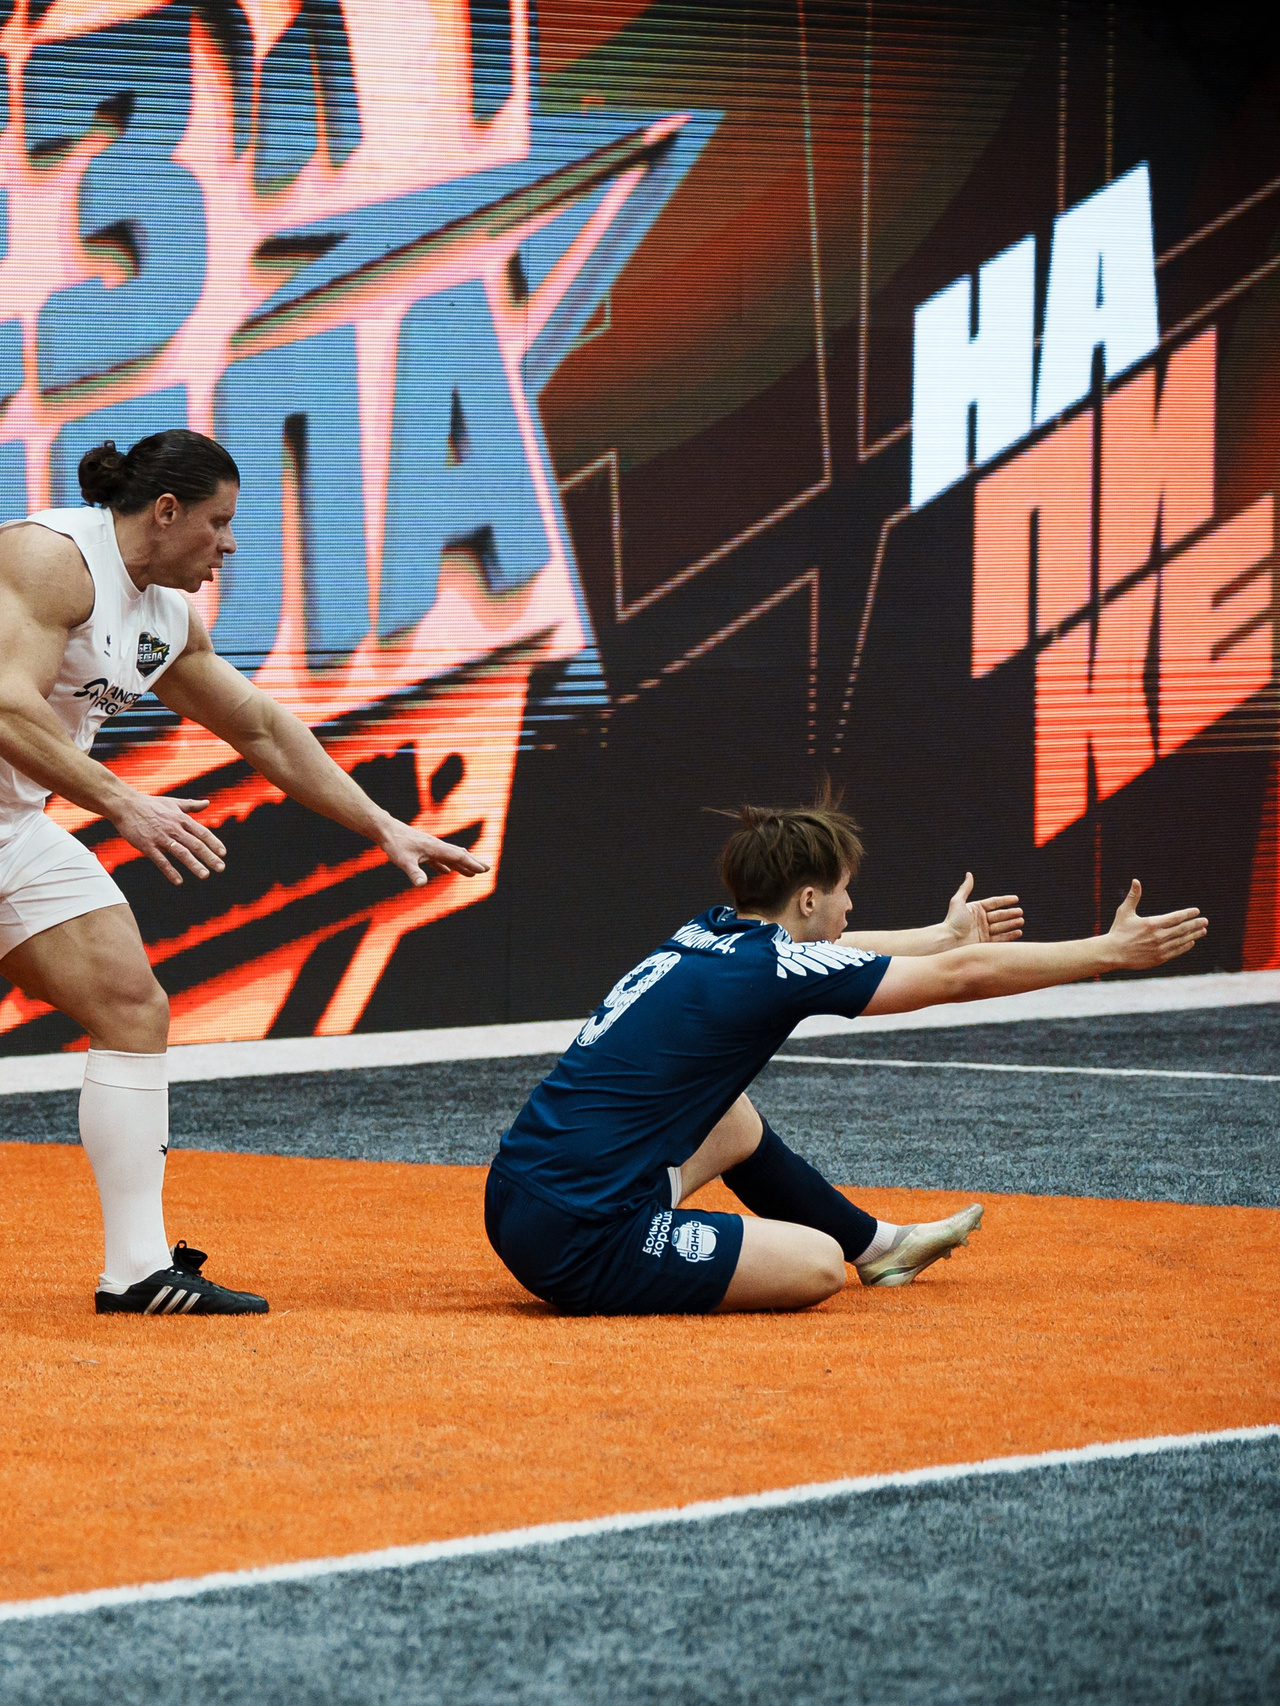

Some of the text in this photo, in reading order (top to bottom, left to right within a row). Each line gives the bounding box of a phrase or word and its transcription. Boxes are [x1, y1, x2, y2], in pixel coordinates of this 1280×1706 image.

[911, 161, 1160, 512] НА
[971, 326, 1217, 679] ПИ
[1034, 494, 1275, 848] КЕ
[576, 951, 682, 1046] 9
[686, 1220, 701, 1261] банка
